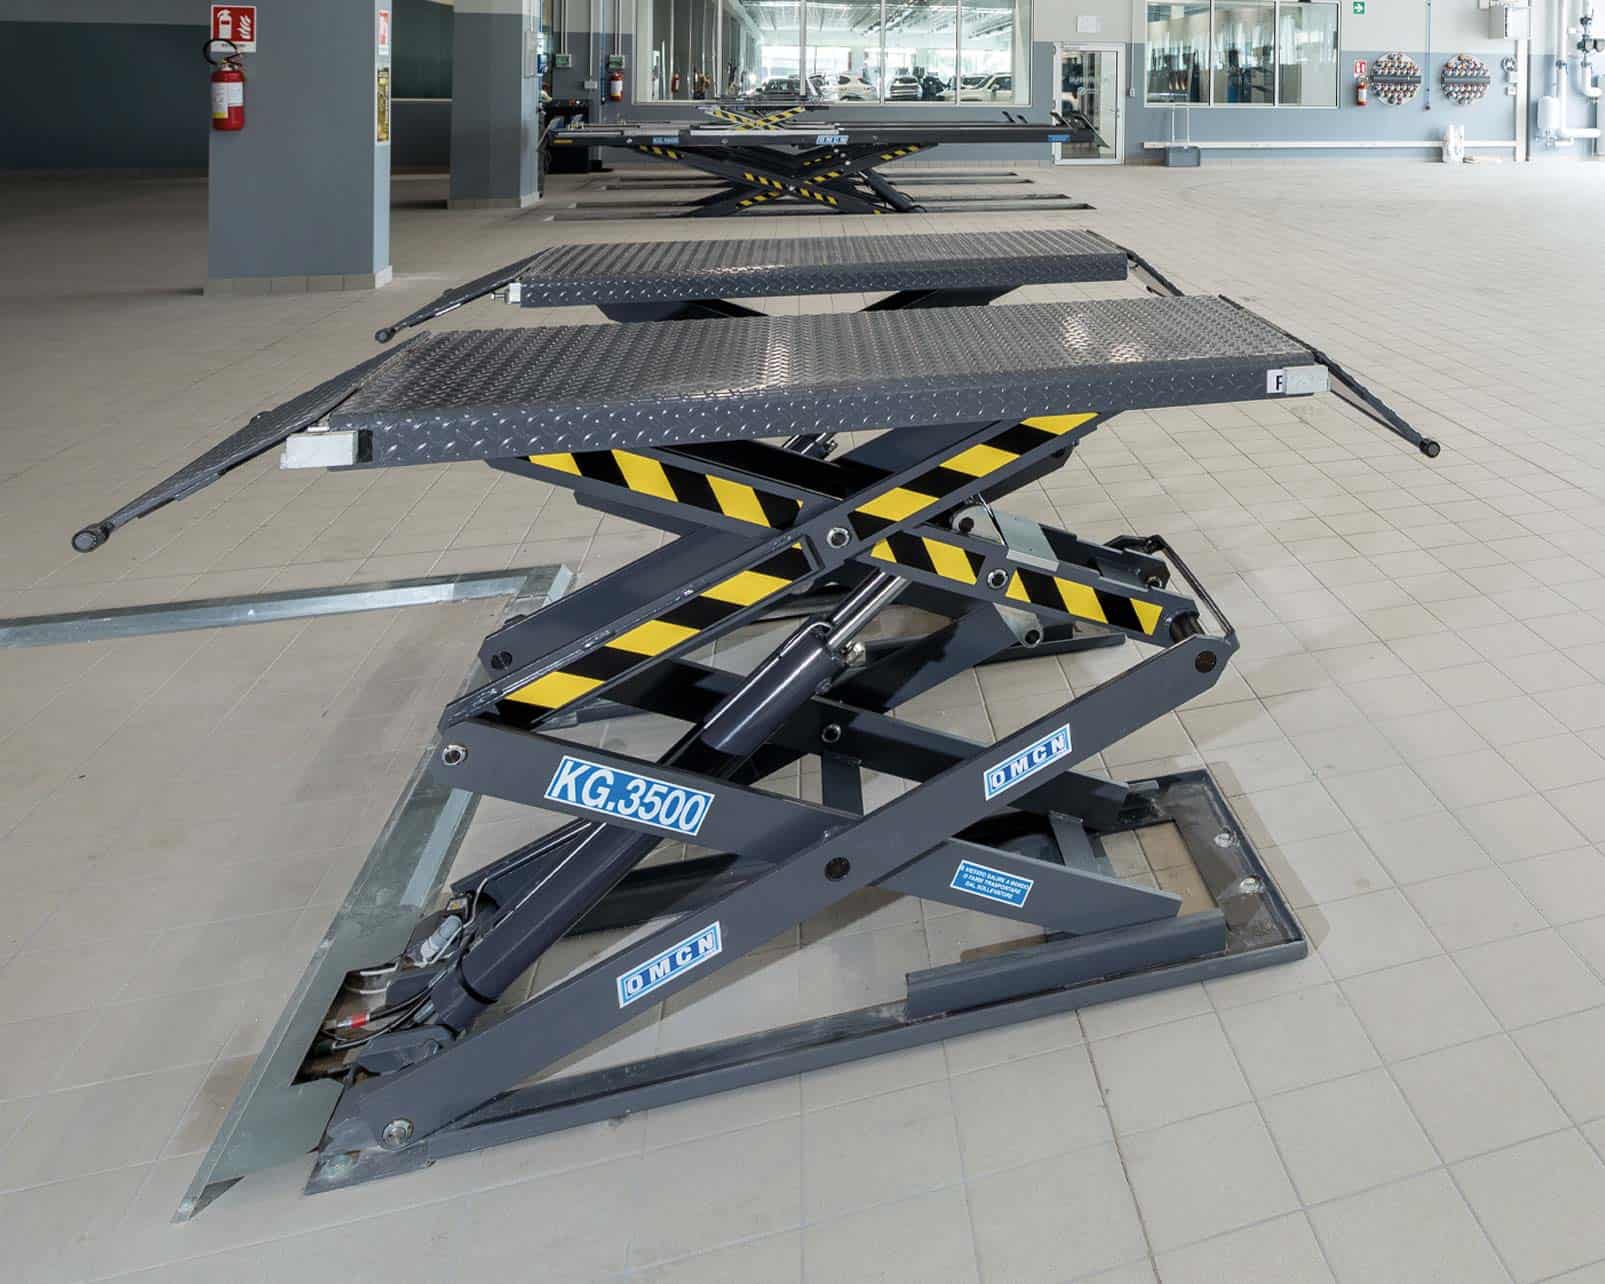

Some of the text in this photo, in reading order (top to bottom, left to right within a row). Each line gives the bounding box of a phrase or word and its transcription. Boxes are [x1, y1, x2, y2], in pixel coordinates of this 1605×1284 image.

[991, 733, 1066, 788] OMCN
[551, 760, 706, 831] KG.3500
[626, 932, 714, 994] OMCN
